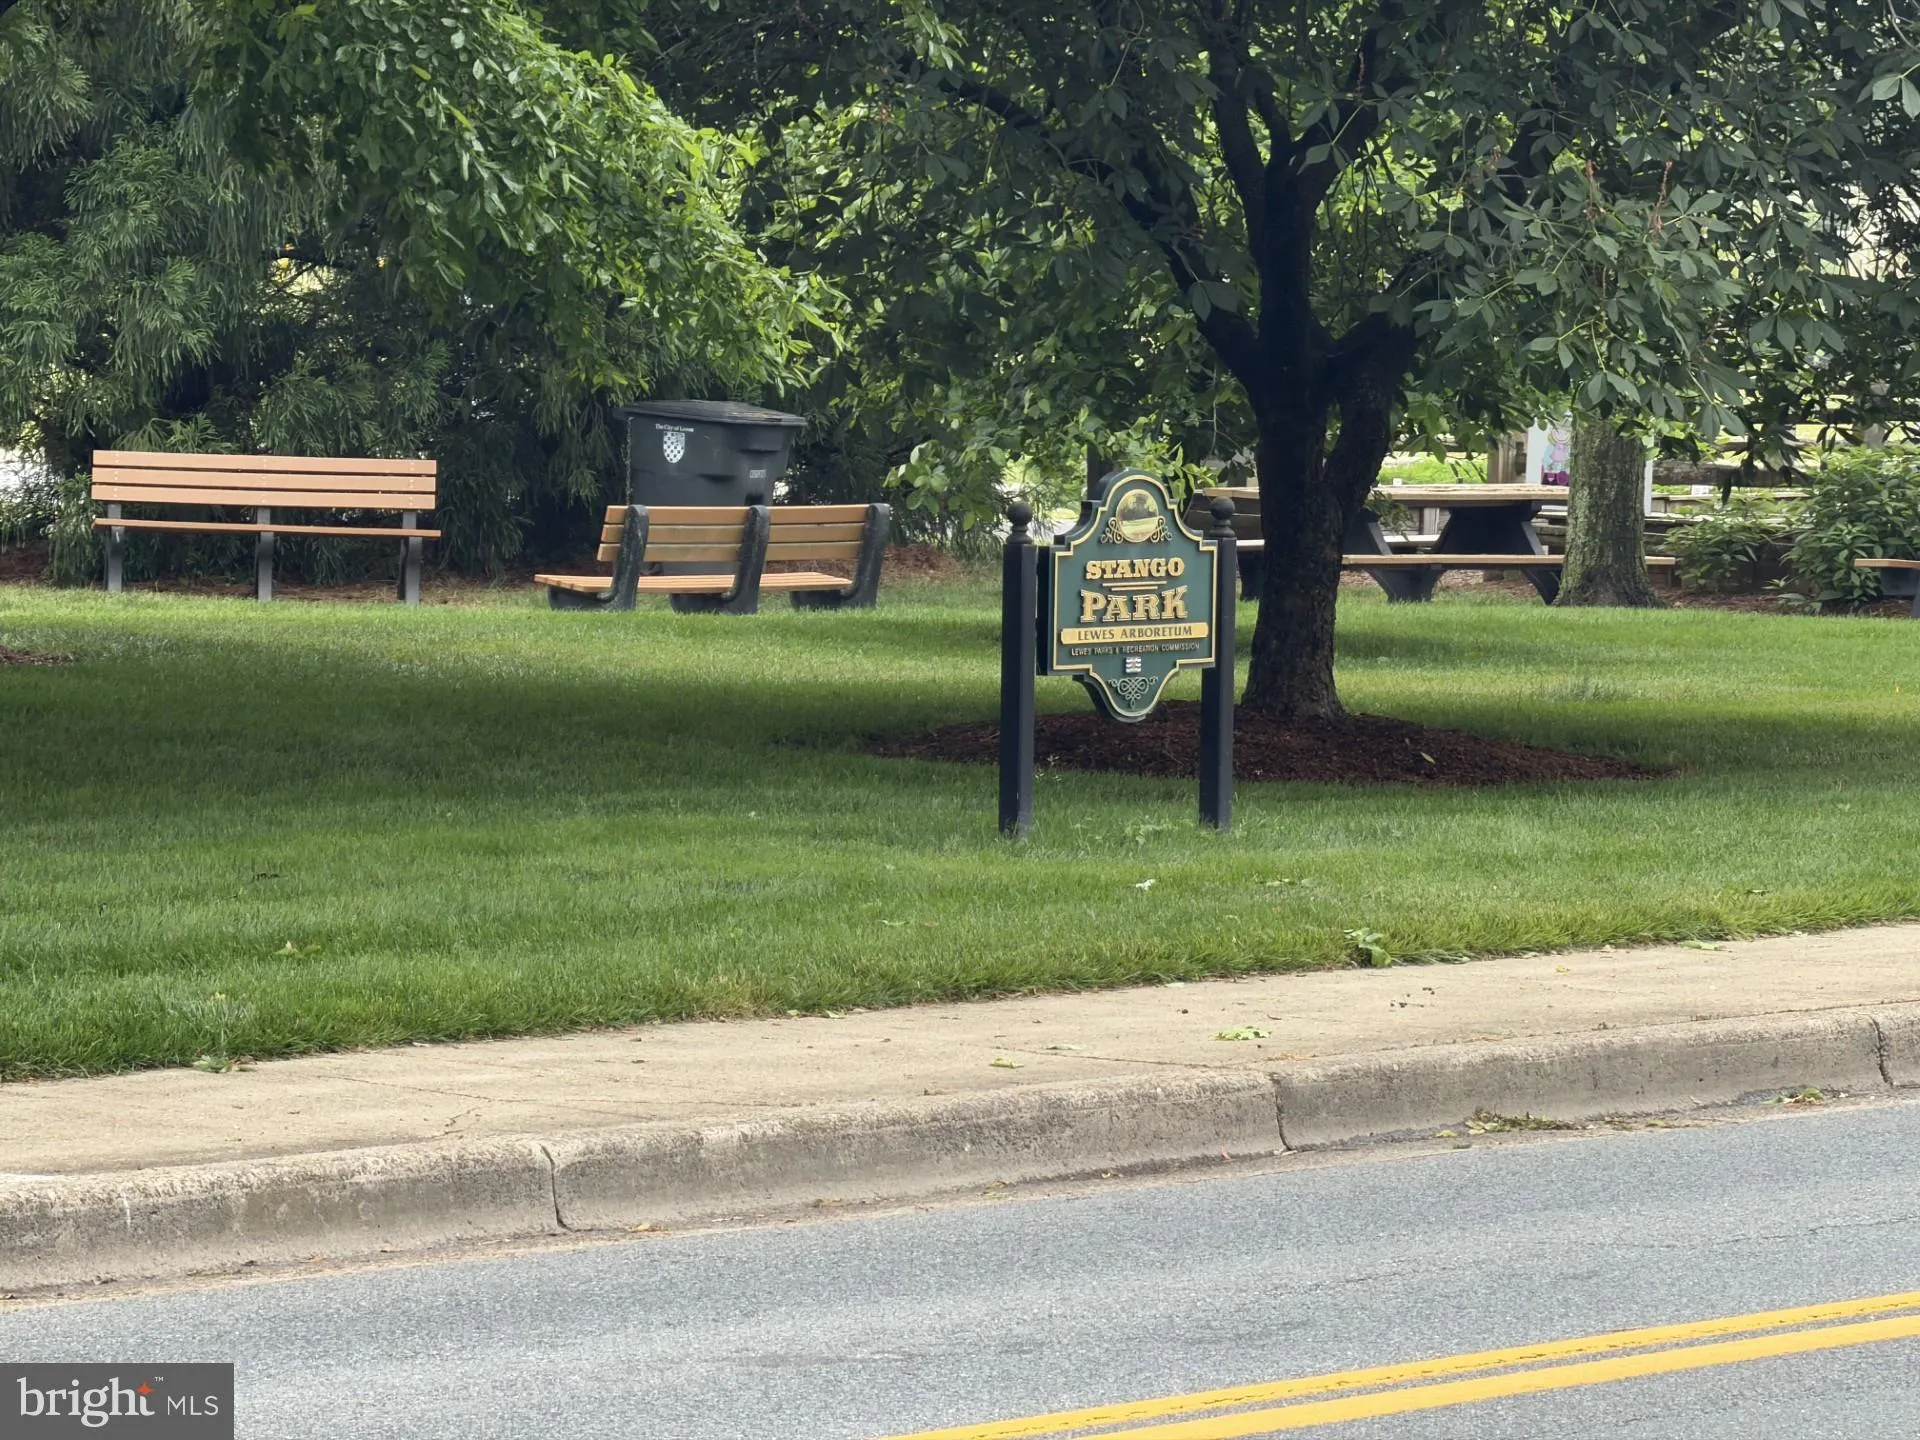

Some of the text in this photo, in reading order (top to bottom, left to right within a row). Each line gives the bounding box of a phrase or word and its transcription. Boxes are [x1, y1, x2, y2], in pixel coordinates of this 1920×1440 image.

[1086, 557, 1185, 579] STANGO
[1080, 585, 1188, 623] PARK
[1078, 625, 1193, 641] LEWES ARBORETUM
[1162, 642, 1200, 652] COMMISSION
